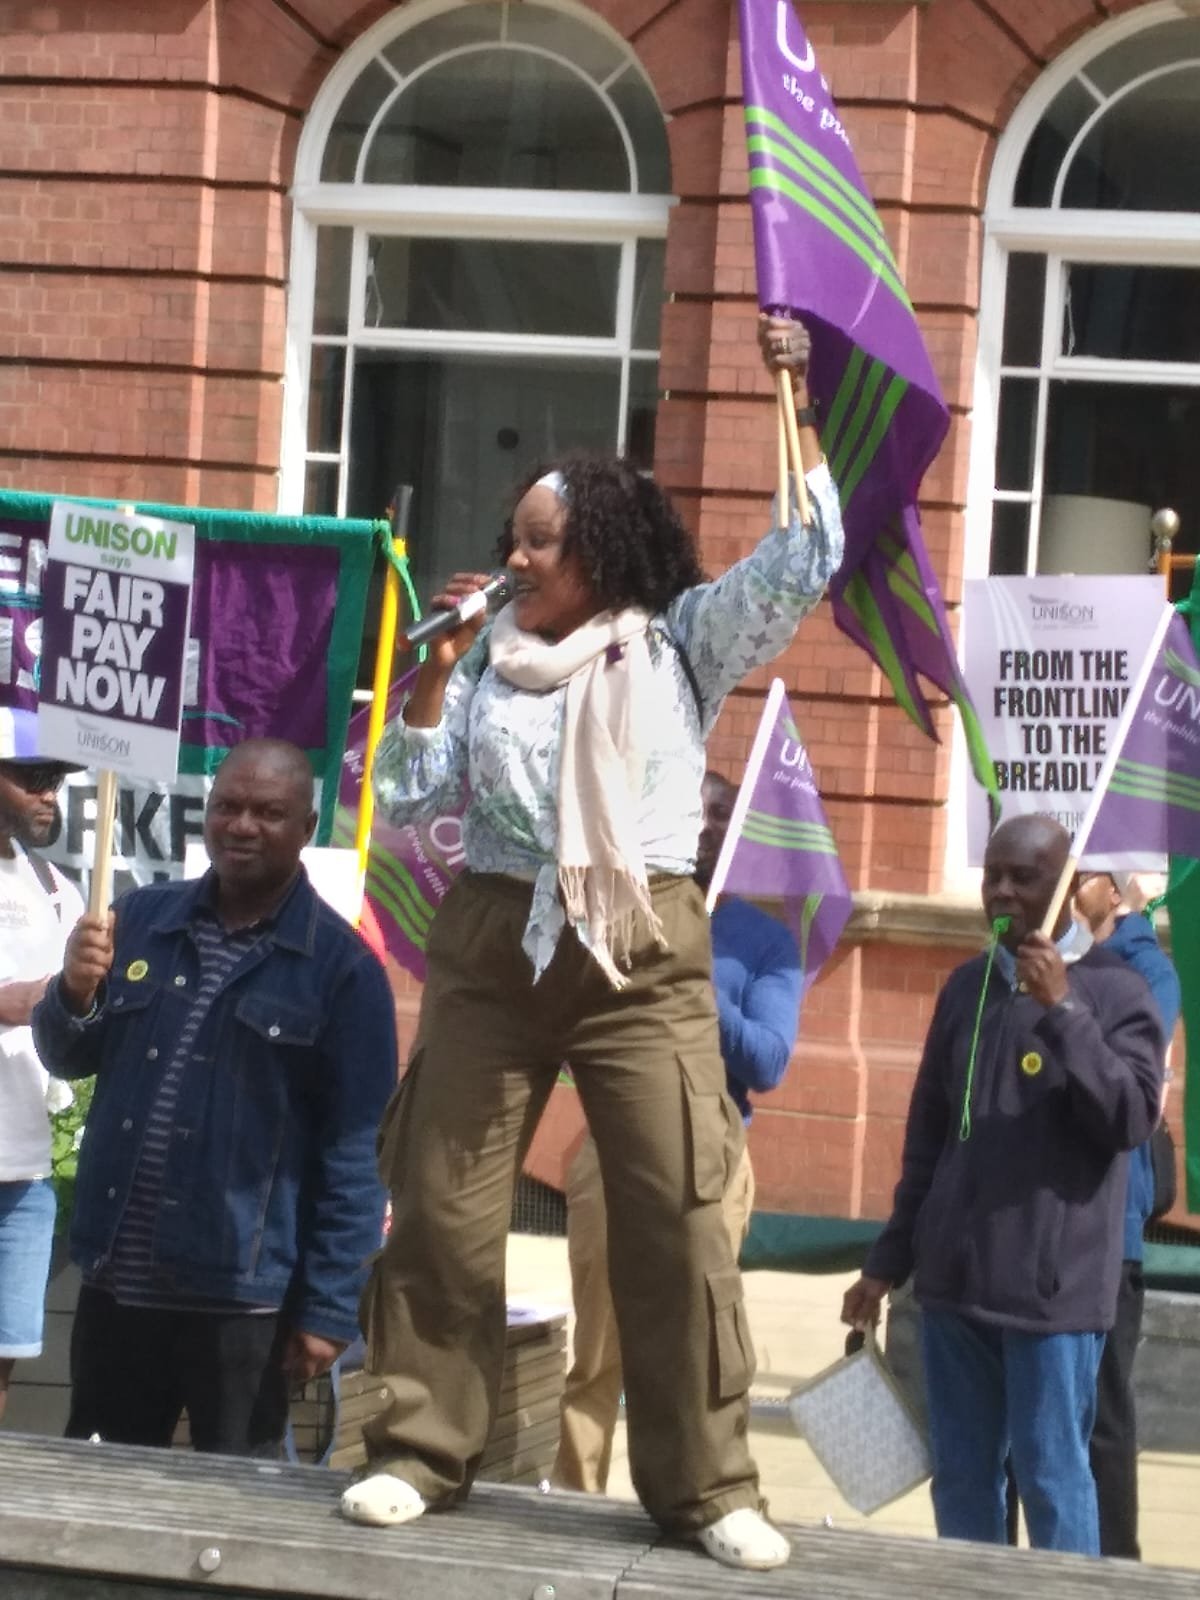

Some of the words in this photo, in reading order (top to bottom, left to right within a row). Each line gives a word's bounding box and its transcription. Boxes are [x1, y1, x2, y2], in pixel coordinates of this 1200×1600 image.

[782, 73, 815, 112] the
[65, 513, 177, 560] UNISON
[100, 553, 131, 569] says
[63, 564, 165, 627] FAIR
[1032, 603, 1094, 621] UNISON
[71, 614, 156, 672] PAY
[1000, 650, 1073, 681] FROM
[1080, 650, 1128, 681] THE
[56, 656, 166, 720] NOW
[77, 731, 131, 757] UNISON
[1021, 724, 1052, 755] TO
[1058, 724, 1106, 755] THE
